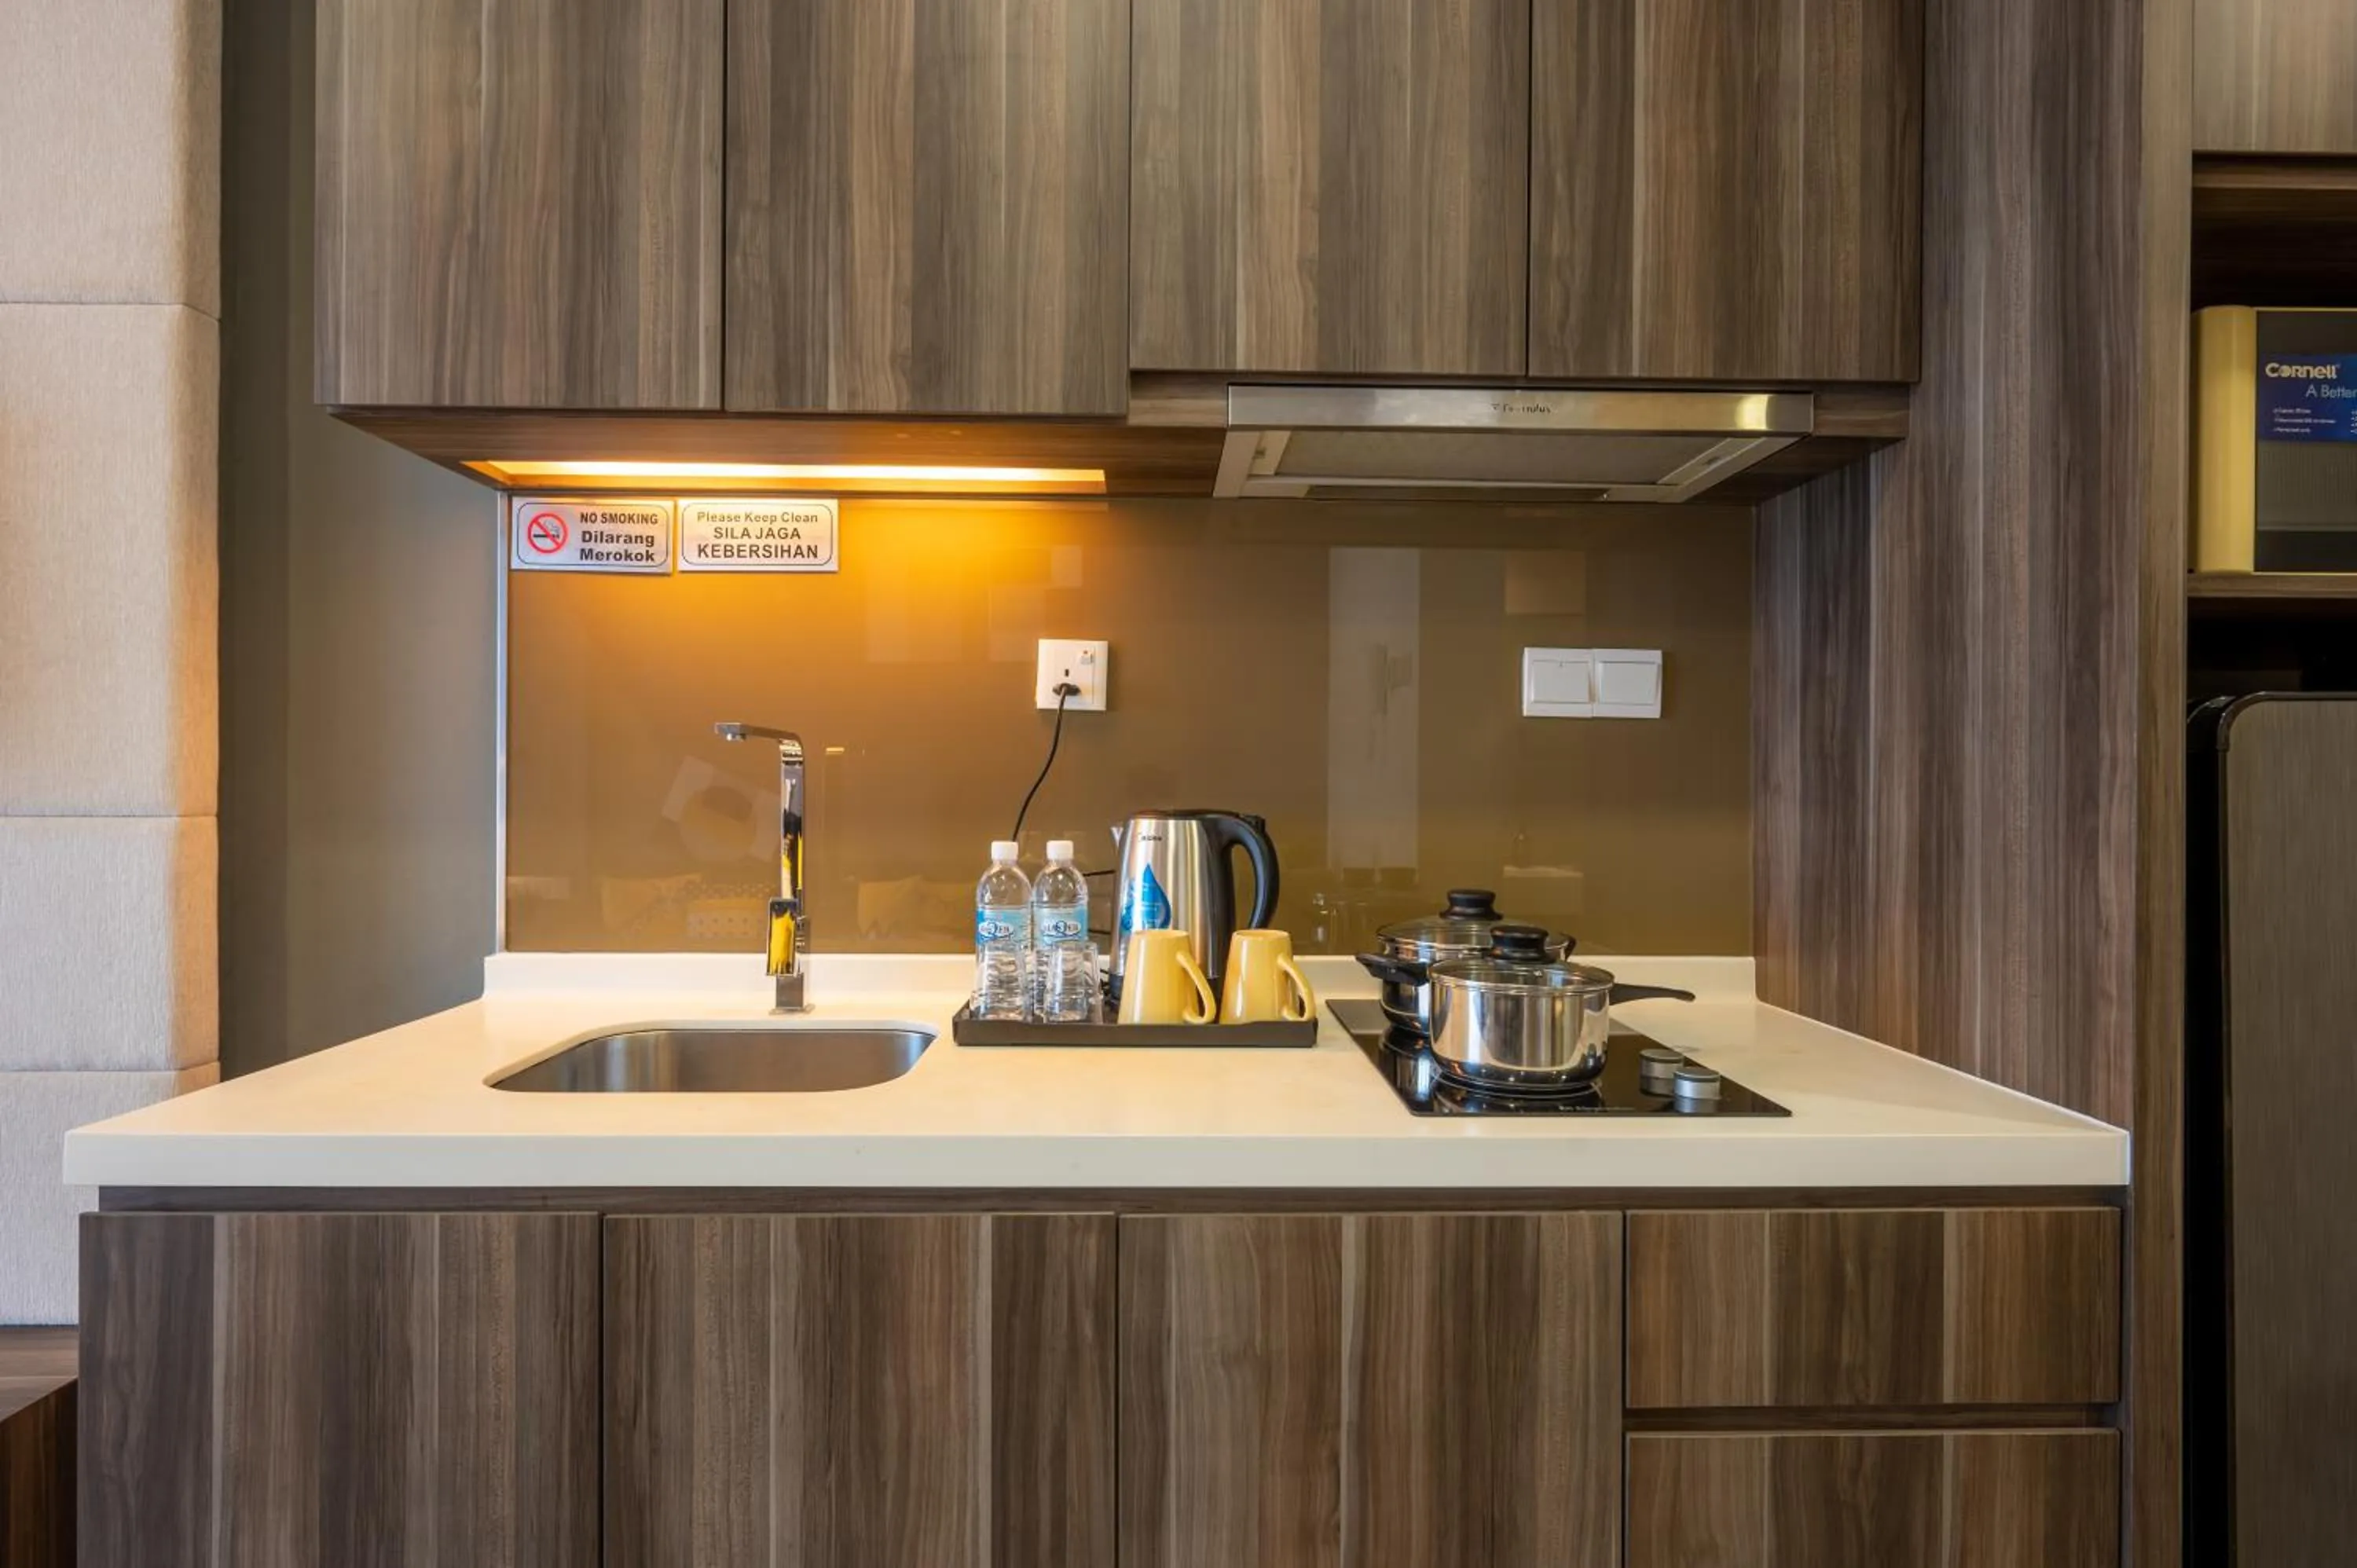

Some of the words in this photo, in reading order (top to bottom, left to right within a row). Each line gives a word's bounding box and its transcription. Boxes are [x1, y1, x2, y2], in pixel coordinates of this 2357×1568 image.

[2265, 362, 2337, 379] Cornell
[2305, 383, 2318, 397] A
[580, 512, 597, 524] NO
[600, 512, 658, 525] SMOKING
[697, 511, 741, 522] Please
[745, 511, 777, 525] Keep
[780, 511, 818, 522] Clean
[581, 530, 655, 548] Dilarang
[713, 526, 751, 540] SILA
[755, 527, 801, 540] JAGA
[580, 548, 655, 562] Merokok
[697, 544, 819, 559] KEBERSIHAN
